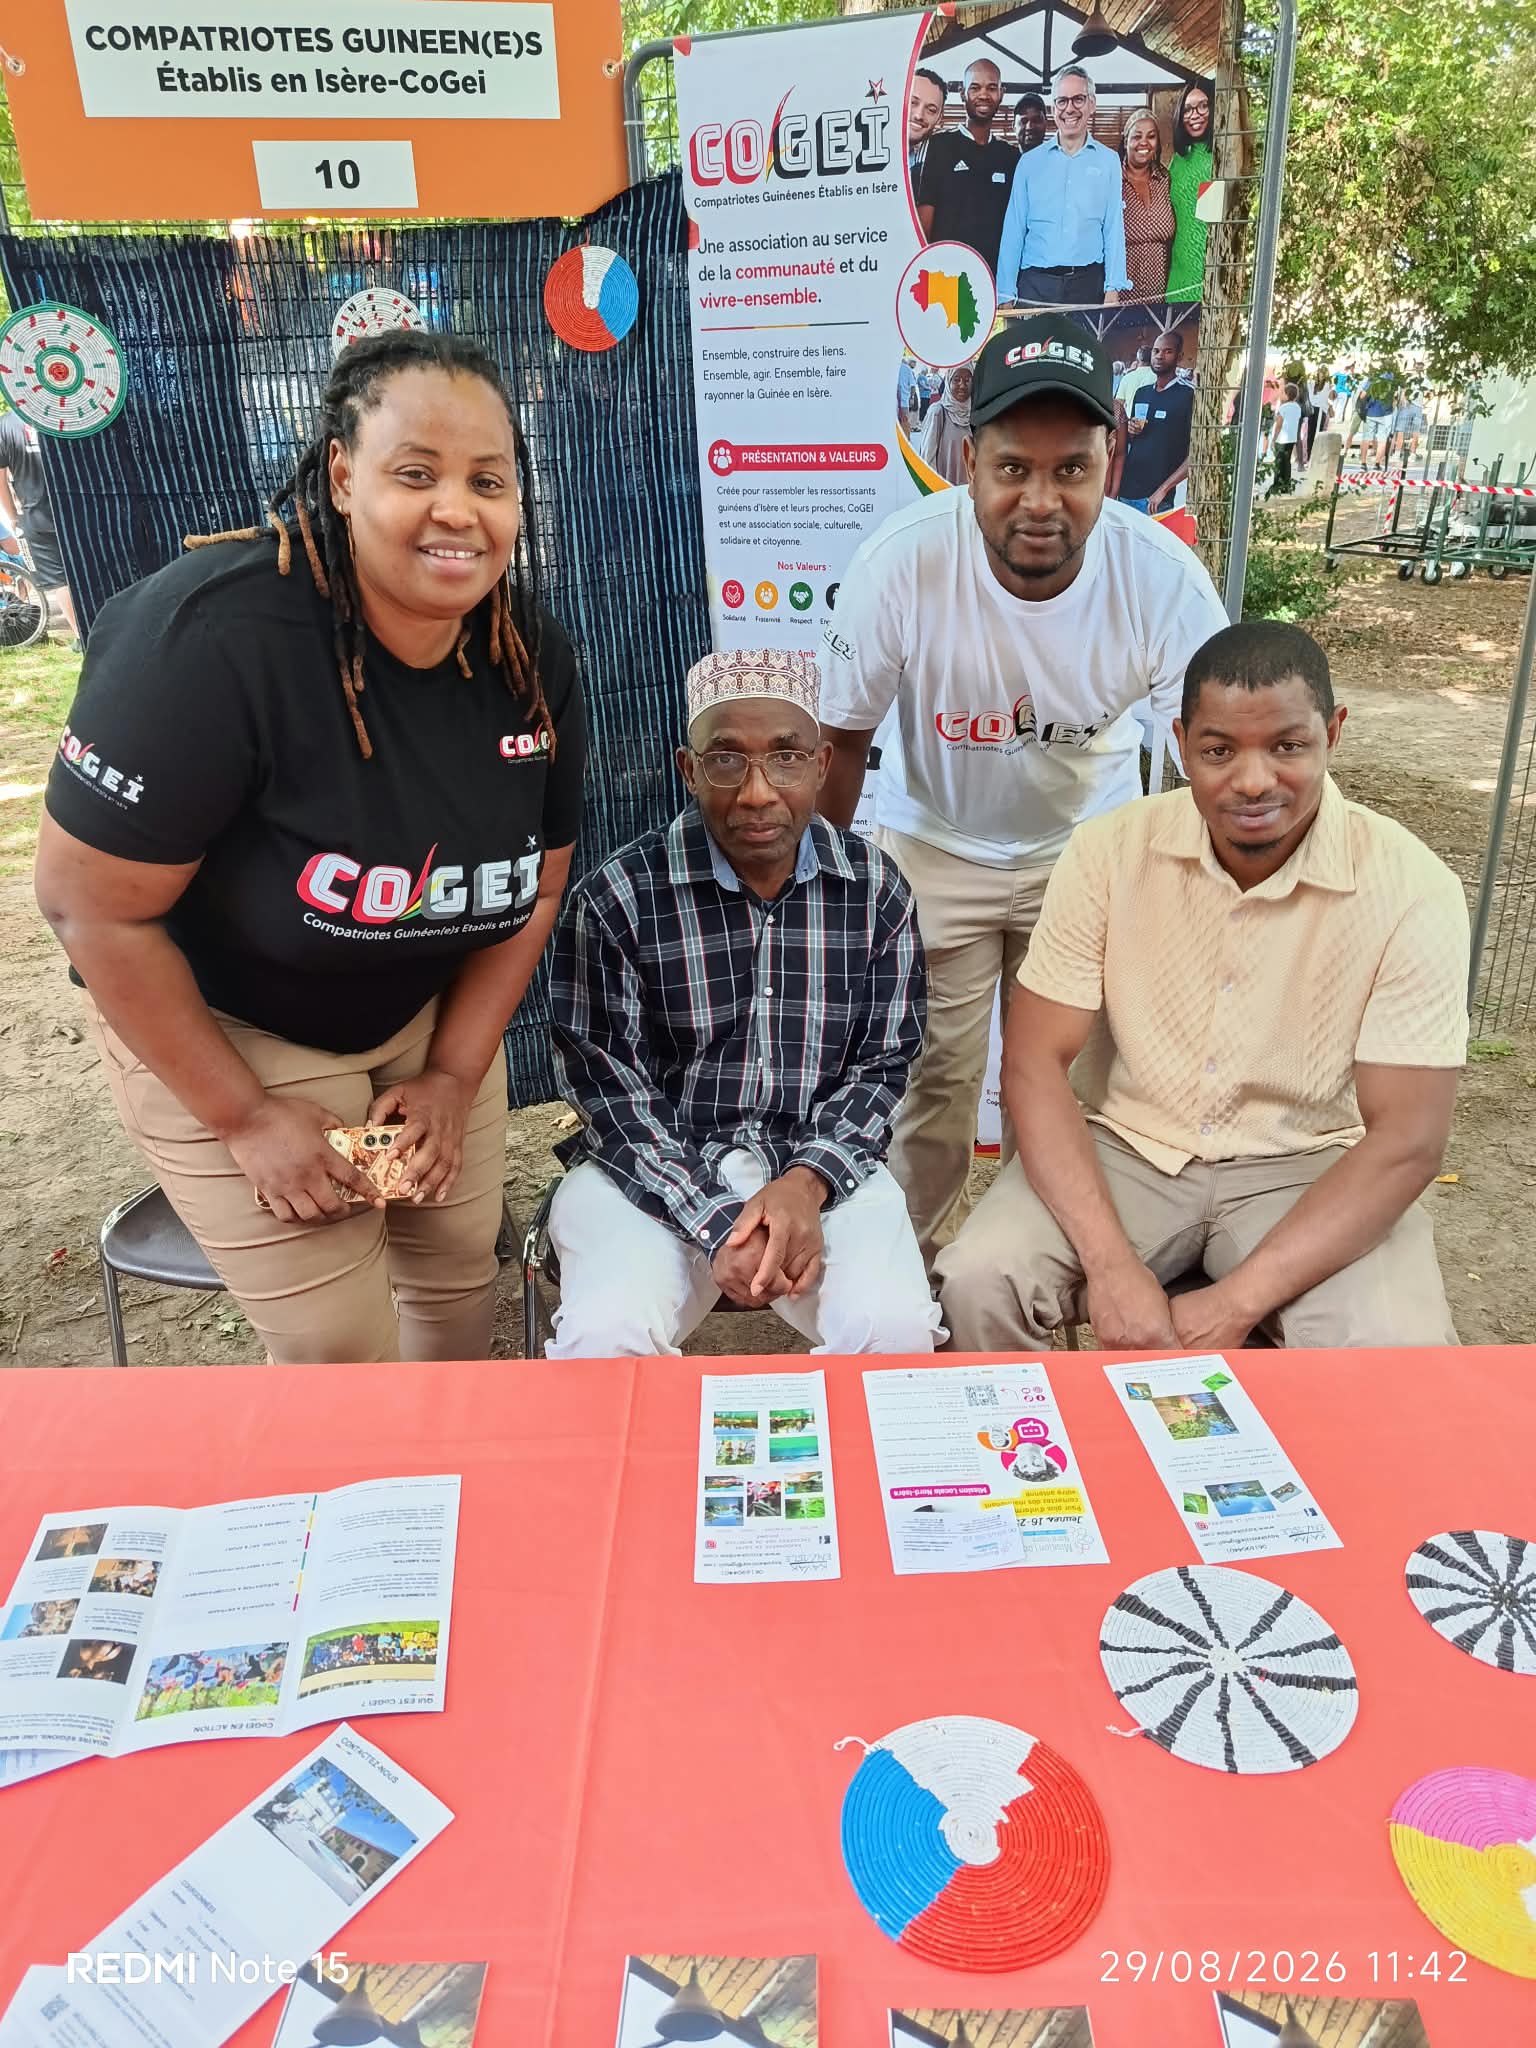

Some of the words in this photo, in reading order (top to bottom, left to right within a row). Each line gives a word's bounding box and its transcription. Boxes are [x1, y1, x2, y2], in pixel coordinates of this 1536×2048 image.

[85, 25, 333, 53] COMPATRIOTES
[342, 27, 543, 59] GUINEEN(E)S
[156, 60, 263, 93] Établis
[271, 72, 307, 93] en
[315, 65, 486, 94] Isère-CoGei
[689, 92, 891, 187] COGEI
[314, 159, 361, 190] 10
[694, 192, 760, 209] Compatriotes
[762, 188, 816, 202] Guinéenes
[818, 183, 854, 198] Établis
[856, 185, 869, 195] en
[872, 181, 898, 194] Isère
[698, 238, 725, 255] Une
[728, 232, 808, 252] association
[812, 233, 830, 247] au
[834, 226, 888, 246] service
[698, 265, 715, 281] de
[719, 264, 732, 281] la
[735, 257, 836, 280] communauté
[839, 257, 855, 274] et
[858, 255, 878, 272] du
[699, 287, 822, 309] vivre-ensemble.
[702, 348, 750, 360] Ensemble,
[752, 347, 800, 359] construire
[802, 345, 820, 357] des
[822, 345, 847, 356] liens.
[1005, 340, 1094, 371] COGEI
[703, 369, 751, 381] Ensemble,
[753, 371, 772, 381] agir.
[774, 366, 823, 379] Ensemble,
[825, 365, 847, 377] faire
[704, 391, 744, 403] rayonner
[746, 388, 755, 399] la
[757, 387, 790, 399] Guinée
[792, 390, 804, 398] en
[807, 387, 832, 398] Isère.
[741, 450, 817, 464] PRÉSENTATION
[819, 451, 827, 463] &
[829, 450, 877, 463] VALEURS
[716, 485, 740, 496] Créée
[742, 488, 760, 498] pour
[762, 486, 805, 496] rassembler
[807, 486, 819, 496] les
[820, 486, 877, 496] ressortissants
[717, 503, 752, 514] guinéens
[753, 503, 779, 513] d'Isère
[780, 505, 789, 513] et
[790, 504, 810, 513] leurs
[811, 504, 846, 515] proches,
[847, 503, 874, 513] CoGEI
[718, 521, 731, 529] est
[732, 521, 747, 529] une
[749, 519, 792, 529] association
[793, 520, 823, 531] sociale,
[823, 520, 863, 531] culturelle,
[720, 535, 751, 545] solidaire
[752, 537, 761, 545] et
[762, 536, 802, 548] citoyenne.
[777, 561, 794, 571] Nos
[795, 561, 827, 571] Valeurs
[722, 613, 747, 622] Solidarité
[789, 616, 813, 625] Respect
[798, 649, 817, 658] Amb
[499, 727, 551, 758] COG
[297, 845, 542, 925] COGEI
[303, 911, 391, 941] Compatriotes
[393, 924, 461, 940] Guinéen(e)s
[498, 918, 512, 928] en
[1015, 1506, 1045, 1514] d'inform
[417, 1697, 434, 1705] QUI
[193, 1723, 228, 1733] ACTION
